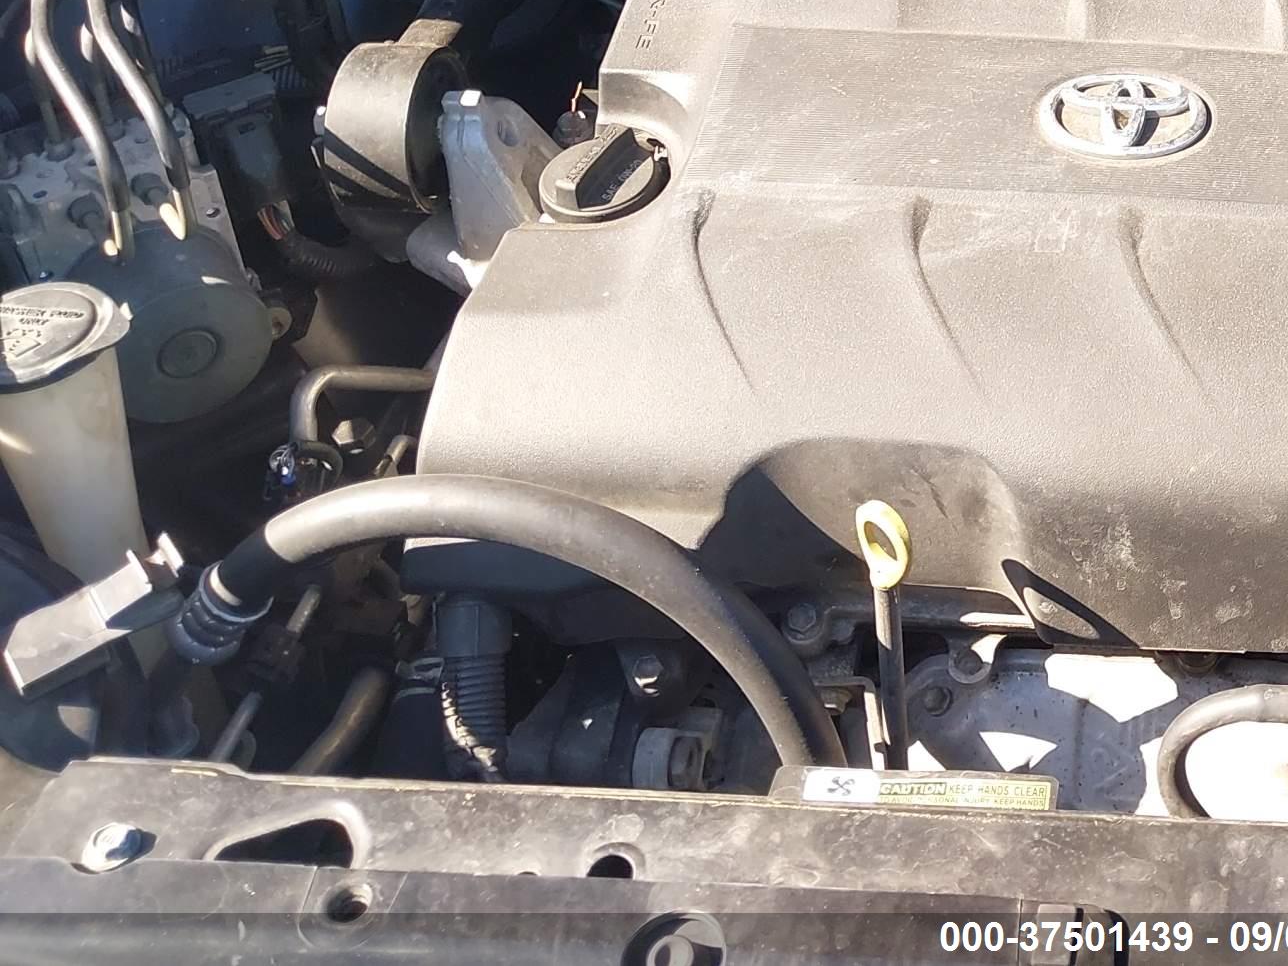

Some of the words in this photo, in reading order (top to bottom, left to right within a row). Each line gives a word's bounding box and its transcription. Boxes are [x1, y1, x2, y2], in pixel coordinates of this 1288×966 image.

[879, 782, 947, 795] CAUTION
[949, 783, 973, 795] KEEP
[978, 784, 1009, 796] HANDS
[1014, 785, 1045, 798] CLEAR
